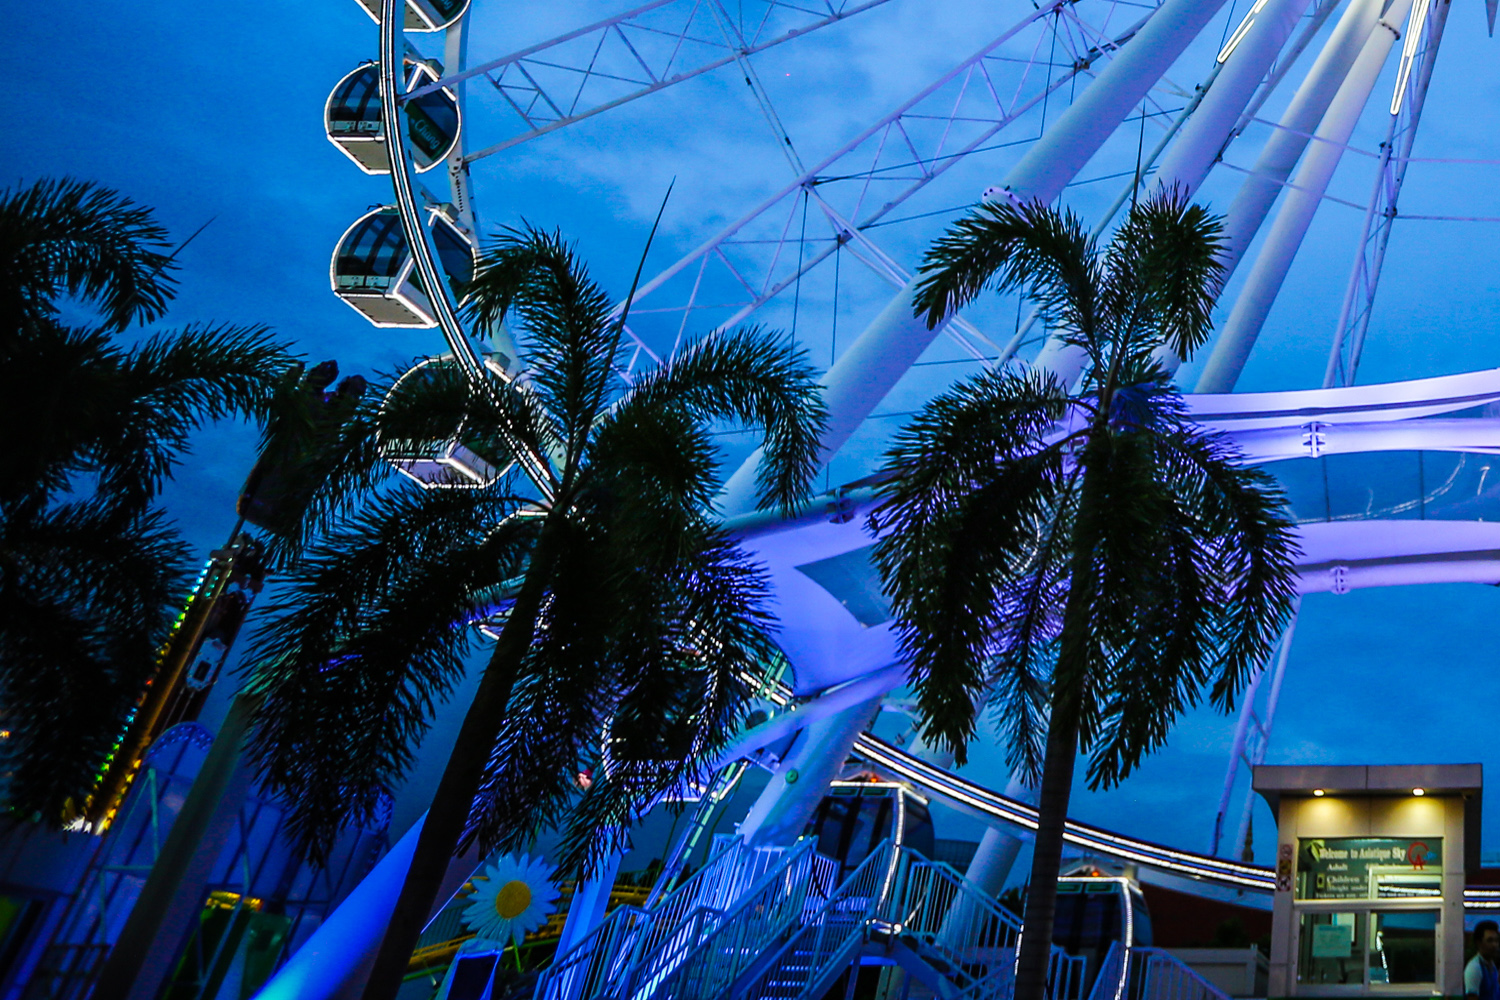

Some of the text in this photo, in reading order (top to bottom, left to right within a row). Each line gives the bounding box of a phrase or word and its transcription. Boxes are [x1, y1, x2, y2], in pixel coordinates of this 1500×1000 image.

[414, 118, 441, 150] Chang
[1318, 847, 1348, 859] Welcome
[1350, 848, 1359, 859] to
[1391, 846, 1406, 862] Sky
